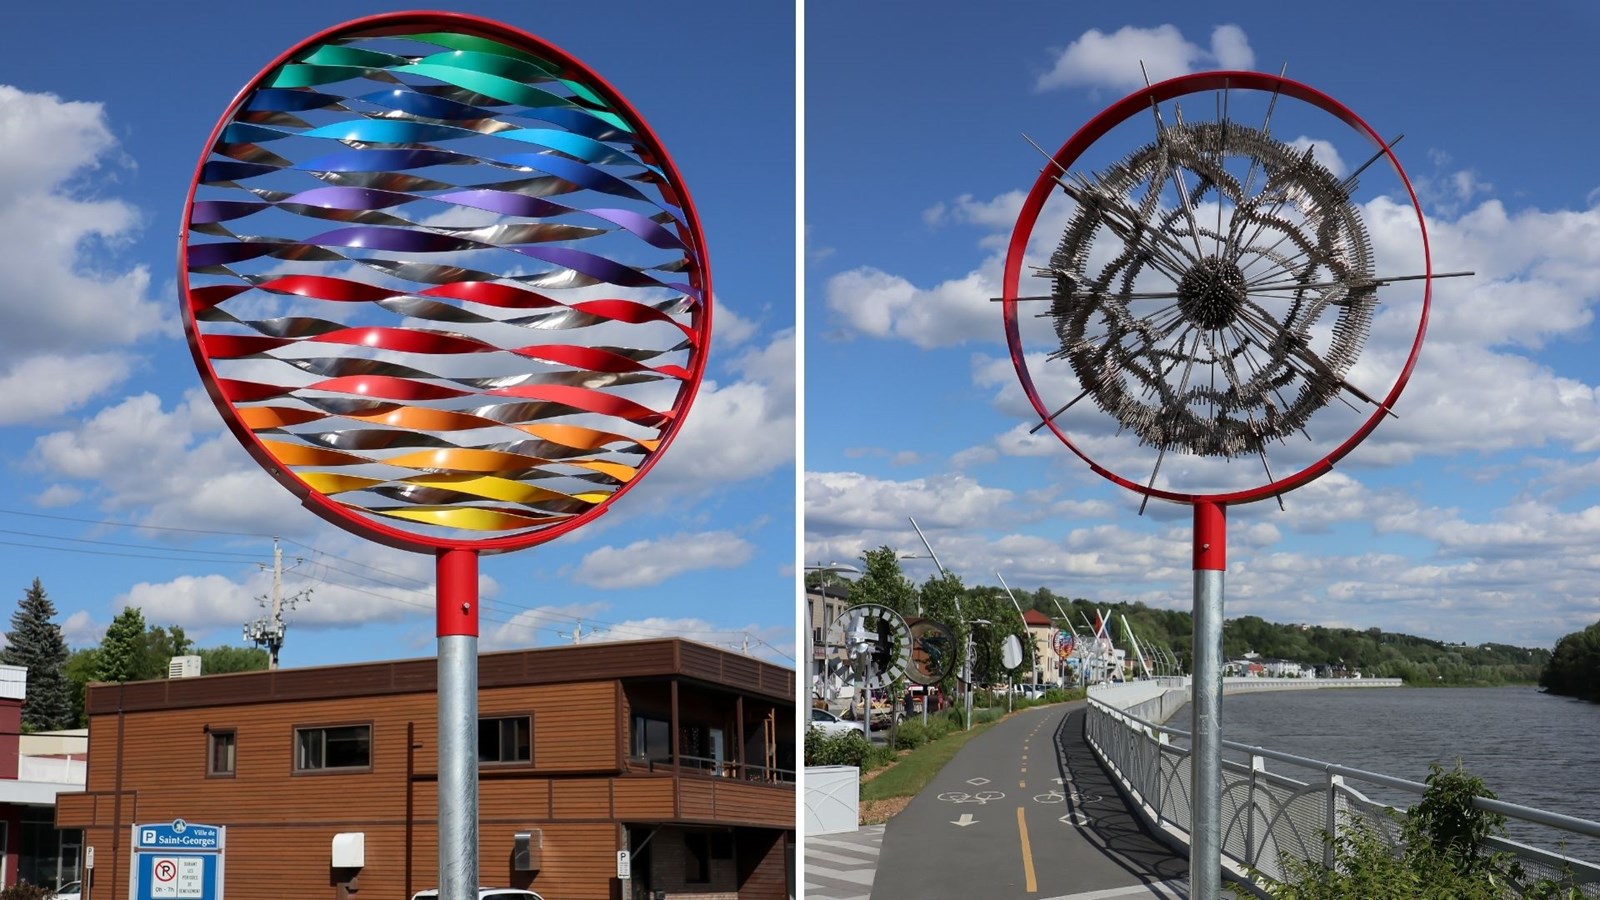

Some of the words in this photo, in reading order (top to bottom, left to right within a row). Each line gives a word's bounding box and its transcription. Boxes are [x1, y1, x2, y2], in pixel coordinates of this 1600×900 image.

[145, 832, 154, 842] P
[158, 836, 215, 848] Saint-Georges
[620, 852, 626, 861] P
